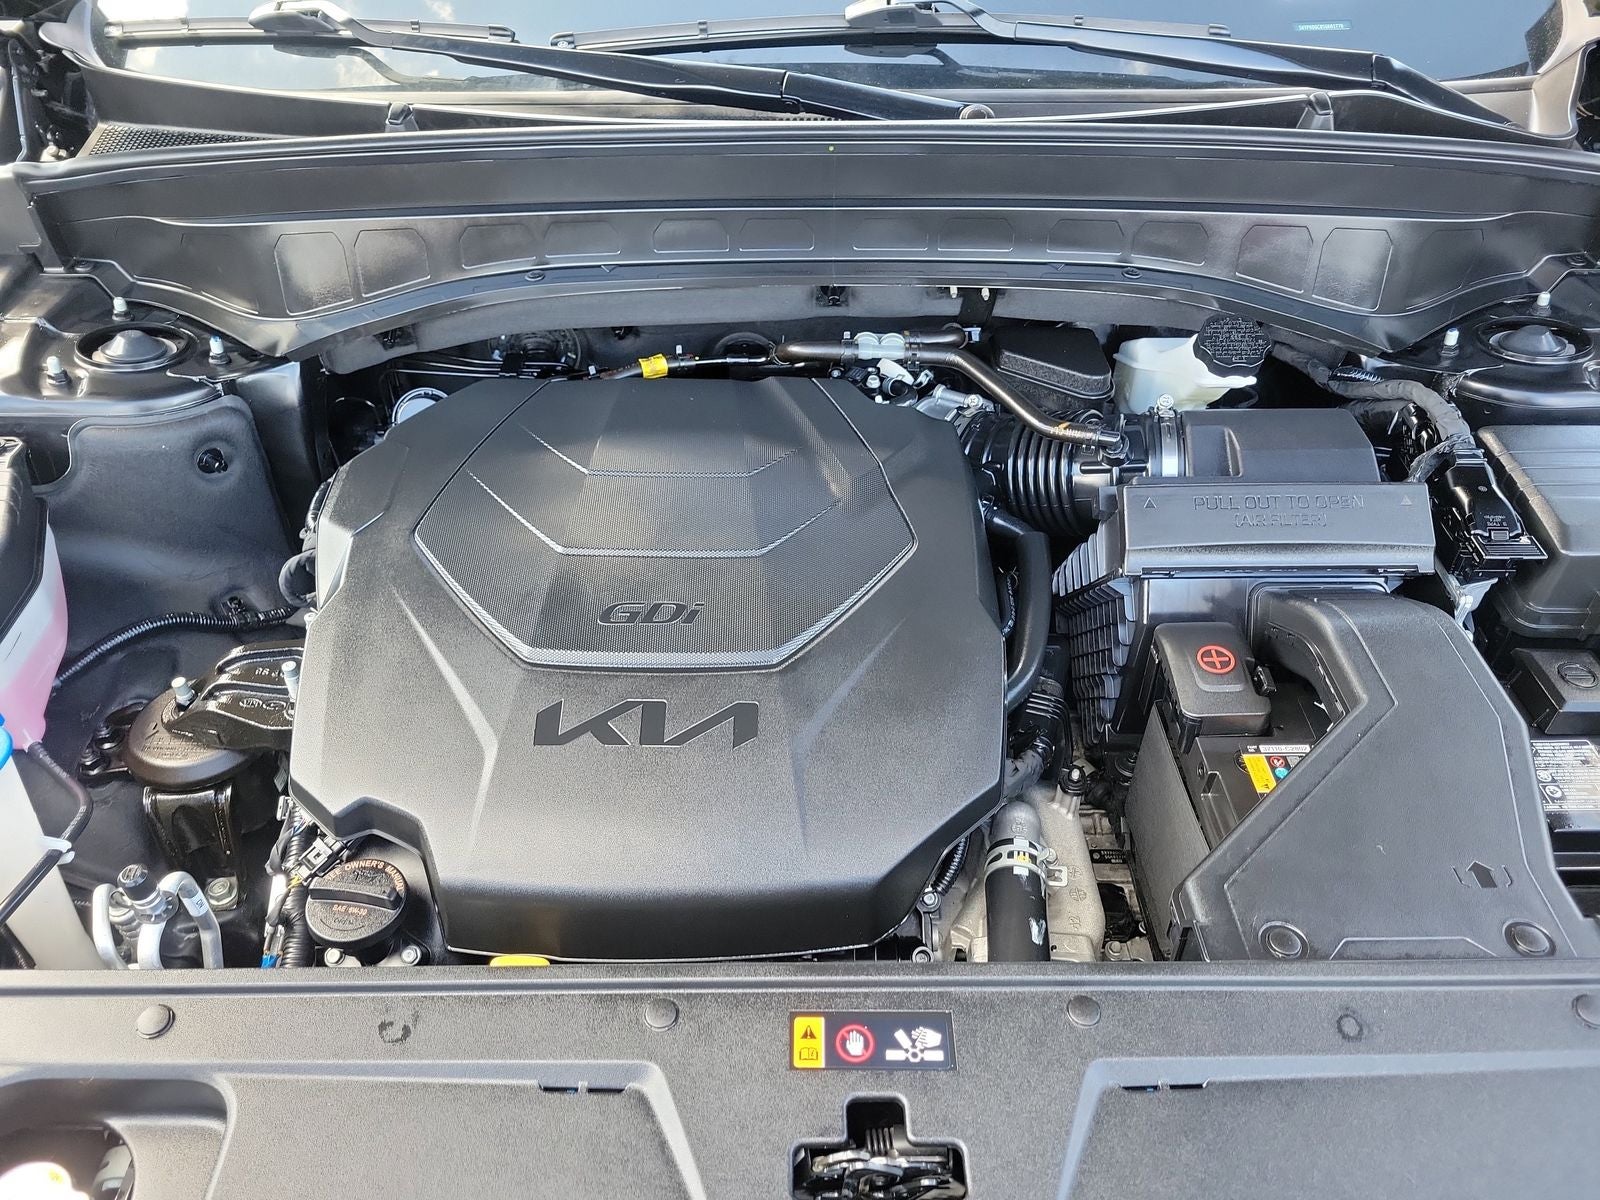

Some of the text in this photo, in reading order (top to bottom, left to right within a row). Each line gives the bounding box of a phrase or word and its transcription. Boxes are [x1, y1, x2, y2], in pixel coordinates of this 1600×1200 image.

[1192, 495, 1364, 510] PULL OUT TO OPEN
[598, 601, 704, 625] GDi
[534, 698, 760, 750] KIA
[344, 859, 385, 871] OWNER'S
[384, 865, 405, 893] MANUAL
[332, 904, 348, 912] SAE
